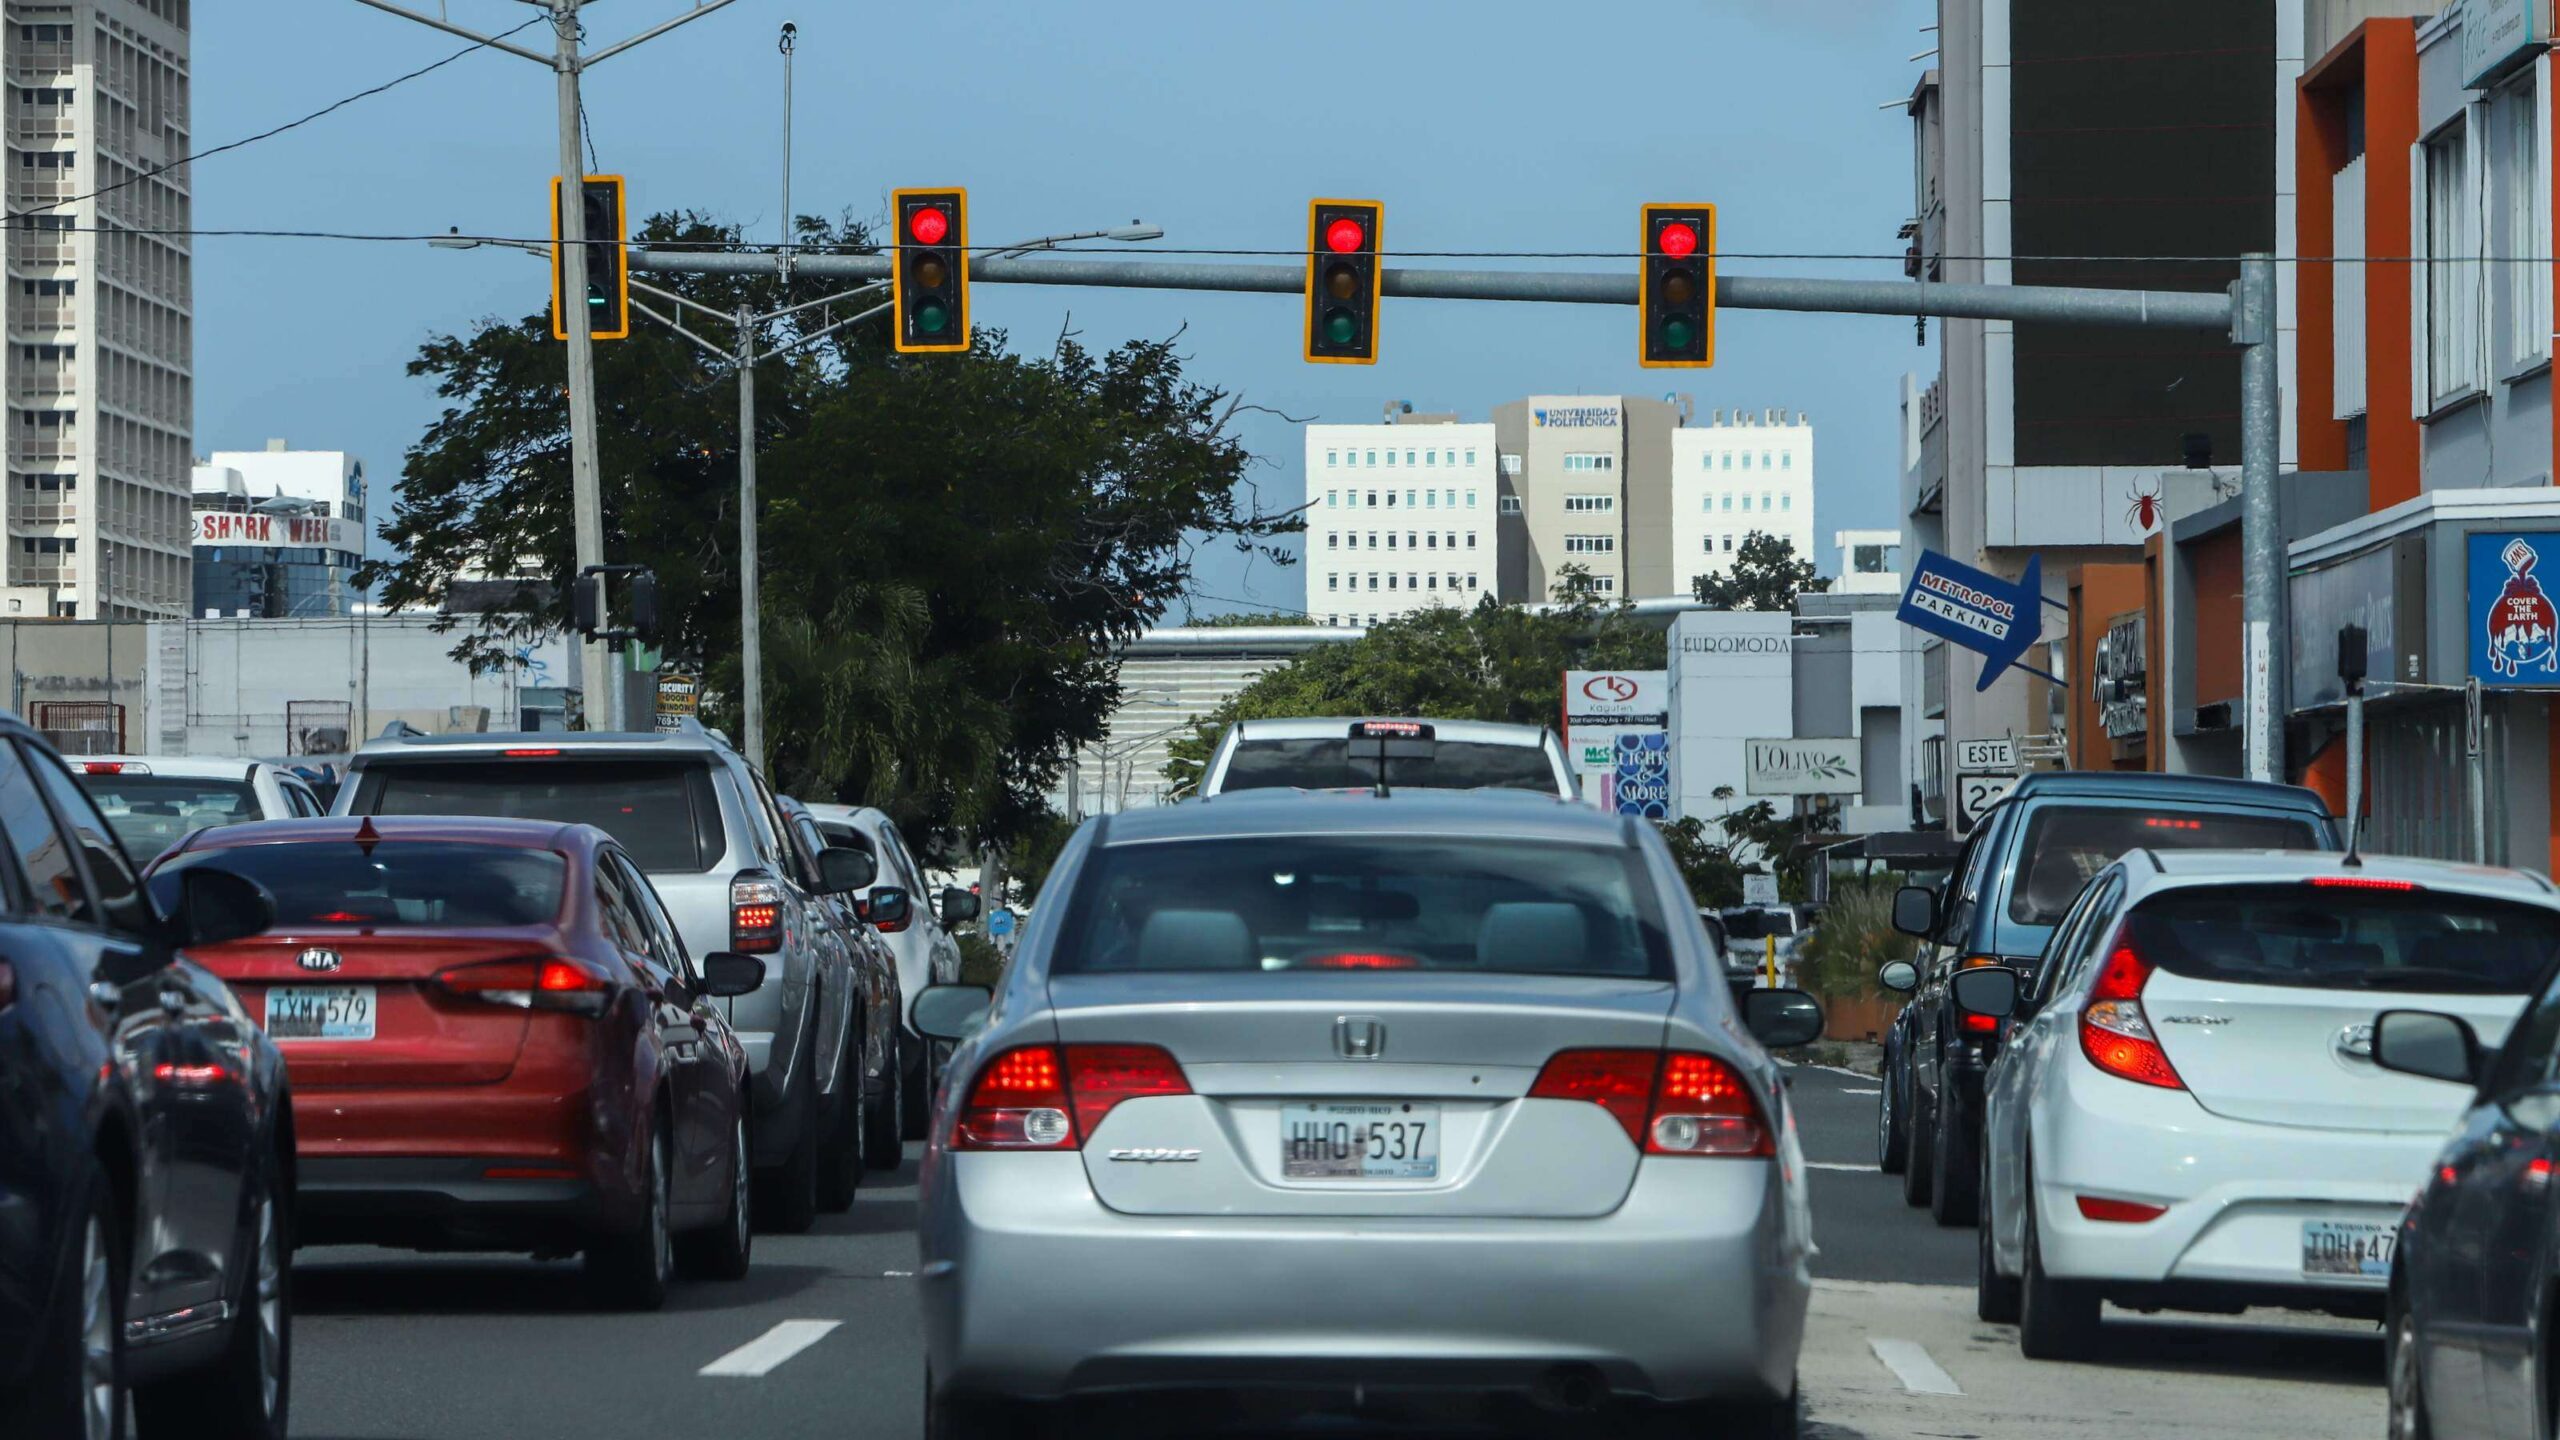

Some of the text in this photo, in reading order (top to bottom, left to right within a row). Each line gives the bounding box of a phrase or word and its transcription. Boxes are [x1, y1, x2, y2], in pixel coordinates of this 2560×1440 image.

[1549, 407, 1618, 417] UNIVERSIDAD
[203, 515, 271, 541] SHARK
[289, 517, 329, 543] WEEK
[1919, 570, 2014, 621] METROPOL
[2507, 597, 2538, 606] COVER
[1916, 593, 2004, 635] PARKING
[2507, 613, 2538, 621] EARTH
[1684, 637, 1789, 653] EUROMODA
[660, 683, 694, 693] SECURITY
[657, 717, 681, 725] 769-9
[1968, 745, 2008, 763] ESTE
[1624, 785, 1668, 801] MORE
[302, 951, 335, 968] KIA
[328, 996, 367, 1023] 579
